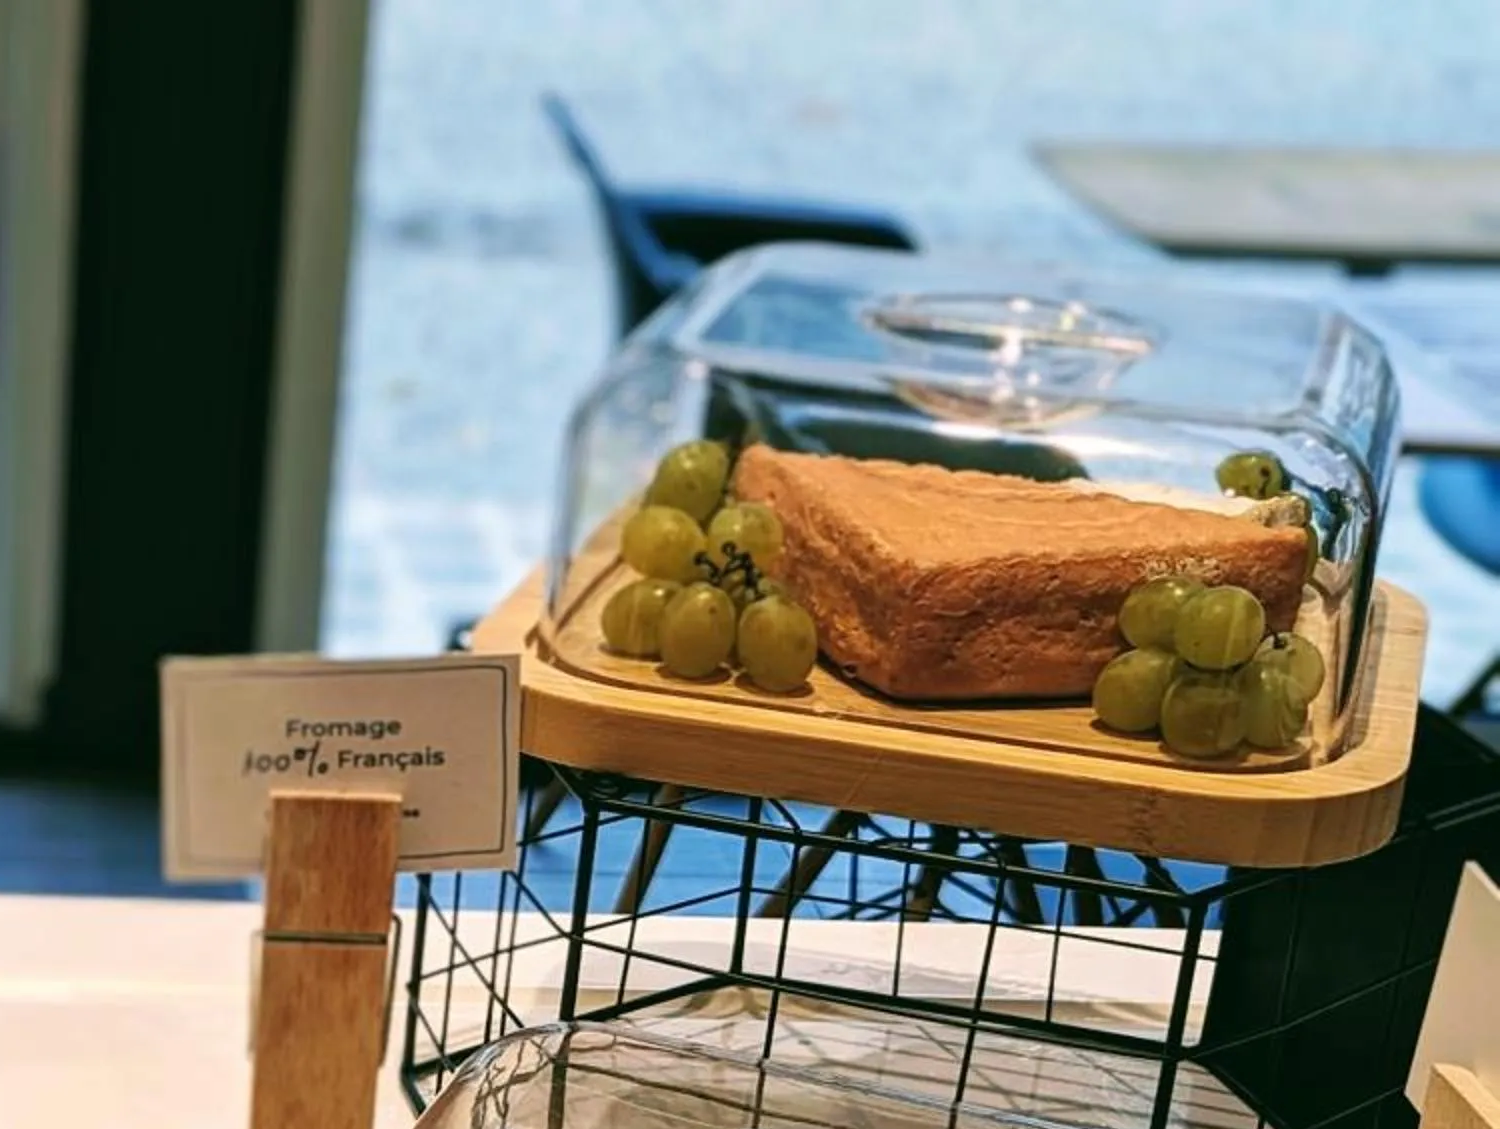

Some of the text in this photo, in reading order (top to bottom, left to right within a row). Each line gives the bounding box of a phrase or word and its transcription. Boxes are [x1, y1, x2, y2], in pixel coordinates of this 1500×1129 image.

[285, 719, 402, 741] Fromage
[242, 741, 447, 777] 100% Français
